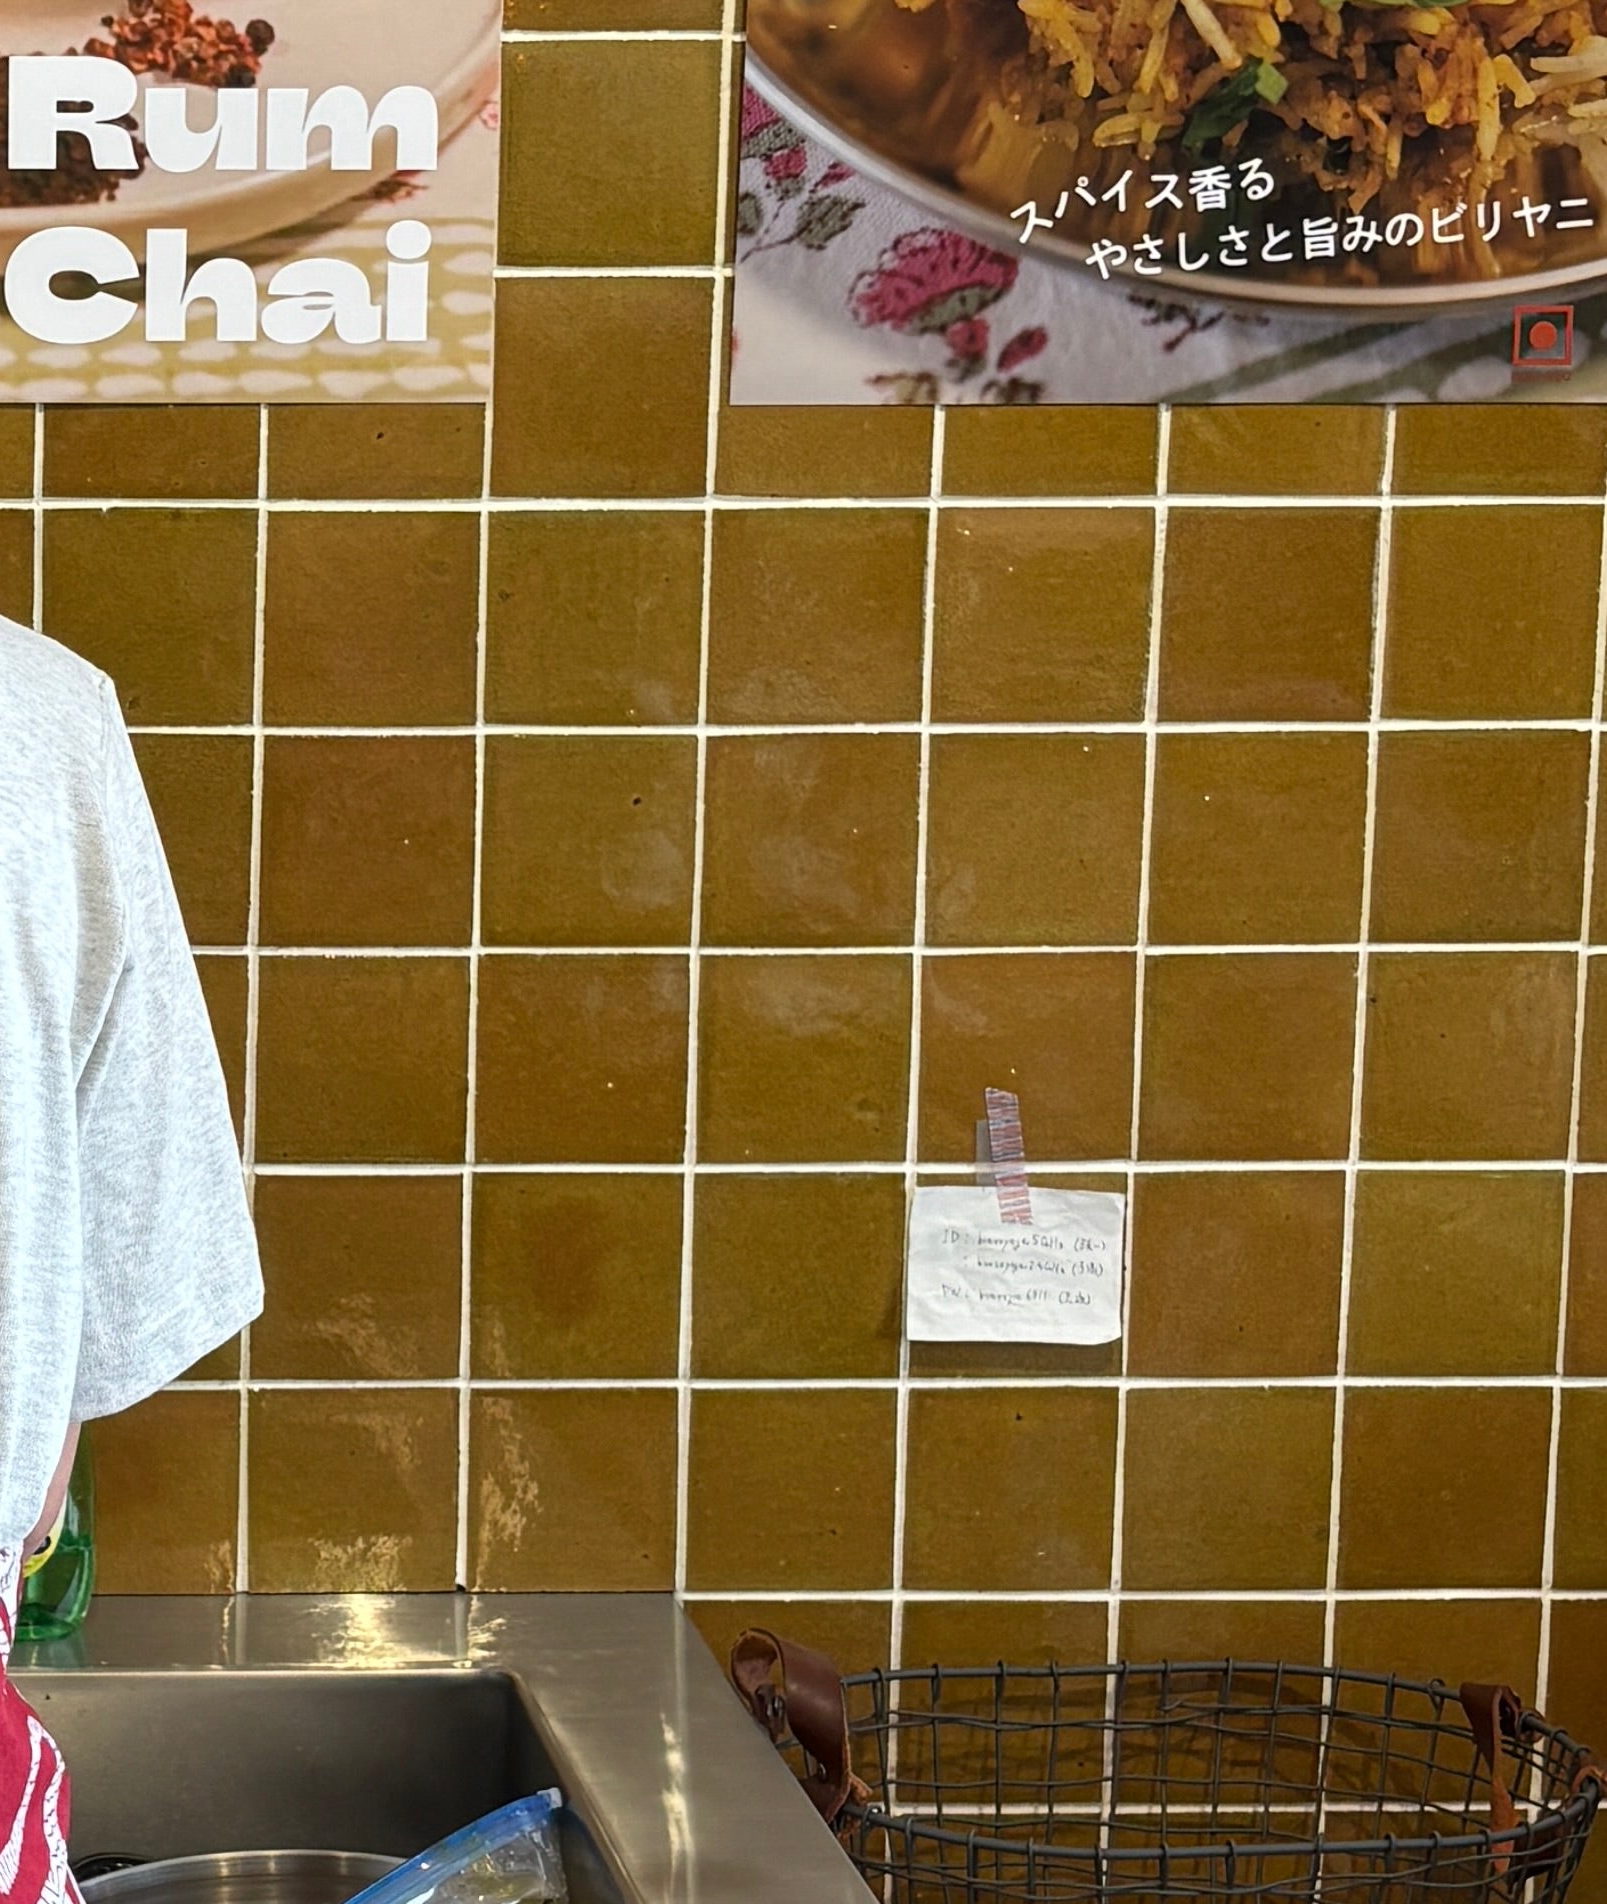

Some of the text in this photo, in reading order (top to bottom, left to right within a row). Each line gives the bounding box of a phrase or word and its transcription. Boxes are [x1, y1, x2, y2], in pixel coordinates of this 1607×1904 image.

[8, 55, 438, 172] Rum
[1010, 157, 1276, 244] スパイス香る
[1085, 197, 1594, 279] やさしさと旨みのビリヤニ
[4, 220, 432, 344] Chai
